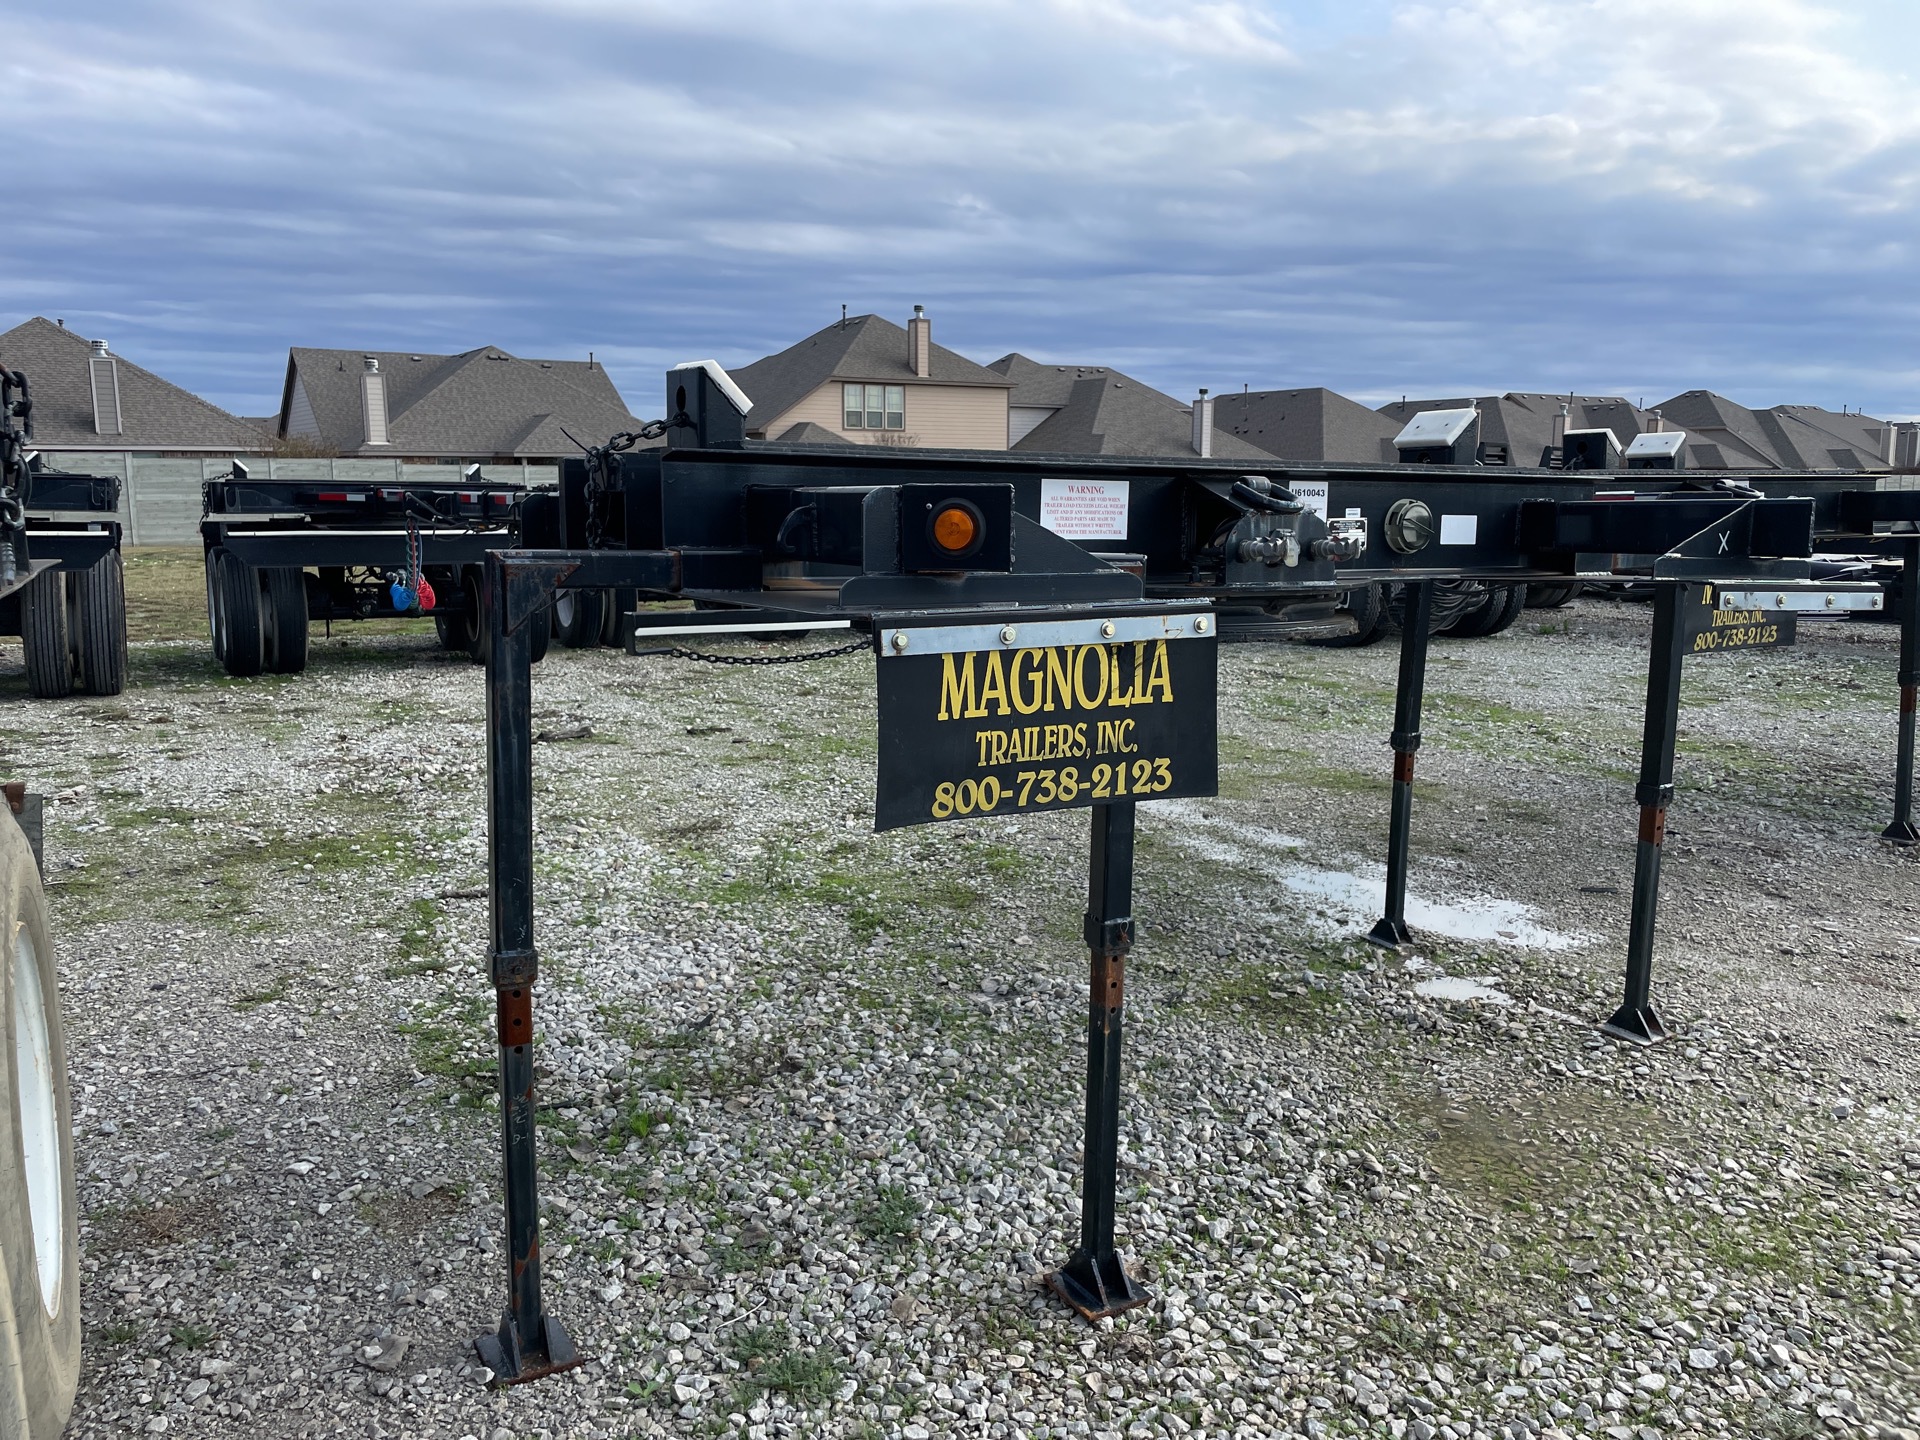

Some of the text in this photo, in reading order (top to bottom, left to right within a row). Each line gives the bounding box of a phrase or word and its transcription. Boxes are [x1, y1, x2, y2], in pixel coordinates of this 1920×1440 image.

[1068, 486, 1104, 494] WARNING
[1718, 530, 1730, 554] X
[1694, 625, 1778, 652] 800-738-2123
[938, 640, 1174, 721] MAGNOLIA
[976, 718, 1138, 766] TRAILERS, INC.
[932, 758, 1172, 818] 800-738-2123
